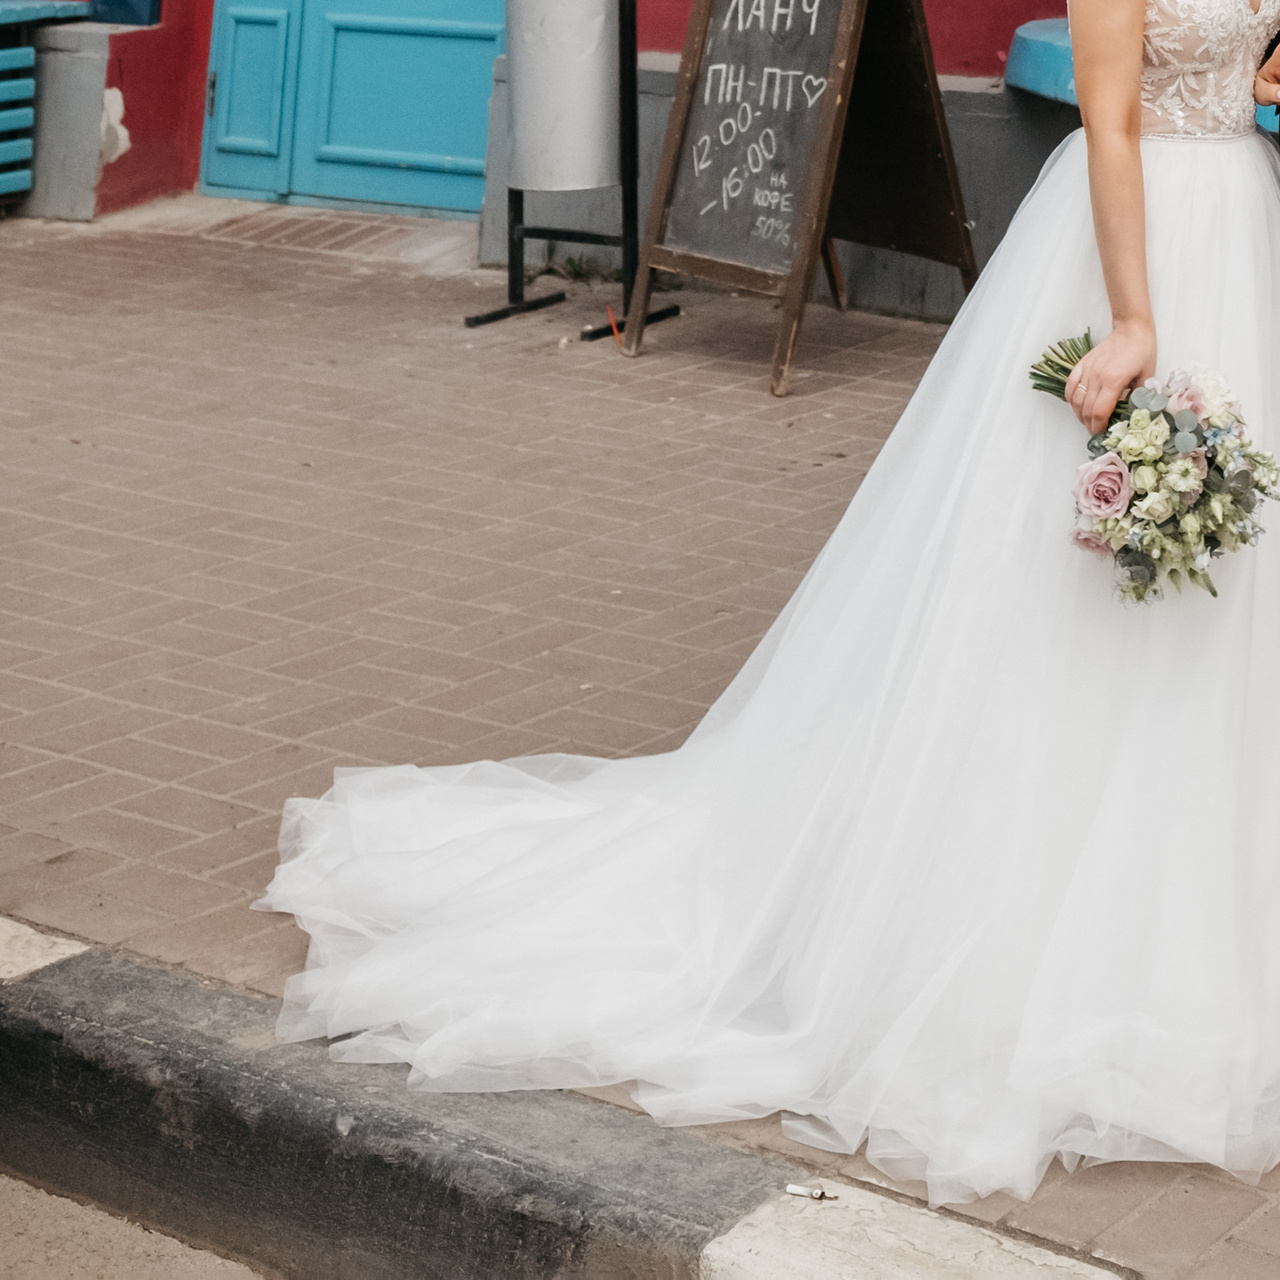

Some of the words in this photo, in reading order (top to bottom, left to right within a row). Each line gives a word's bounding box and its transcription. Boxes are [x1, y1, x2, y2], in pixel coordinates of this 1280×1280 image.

[704, 62, 804, 112] ПН-ПТ
[769, 171, 788, 190] НА
[752, 187, 794, 213] КОФЕ
